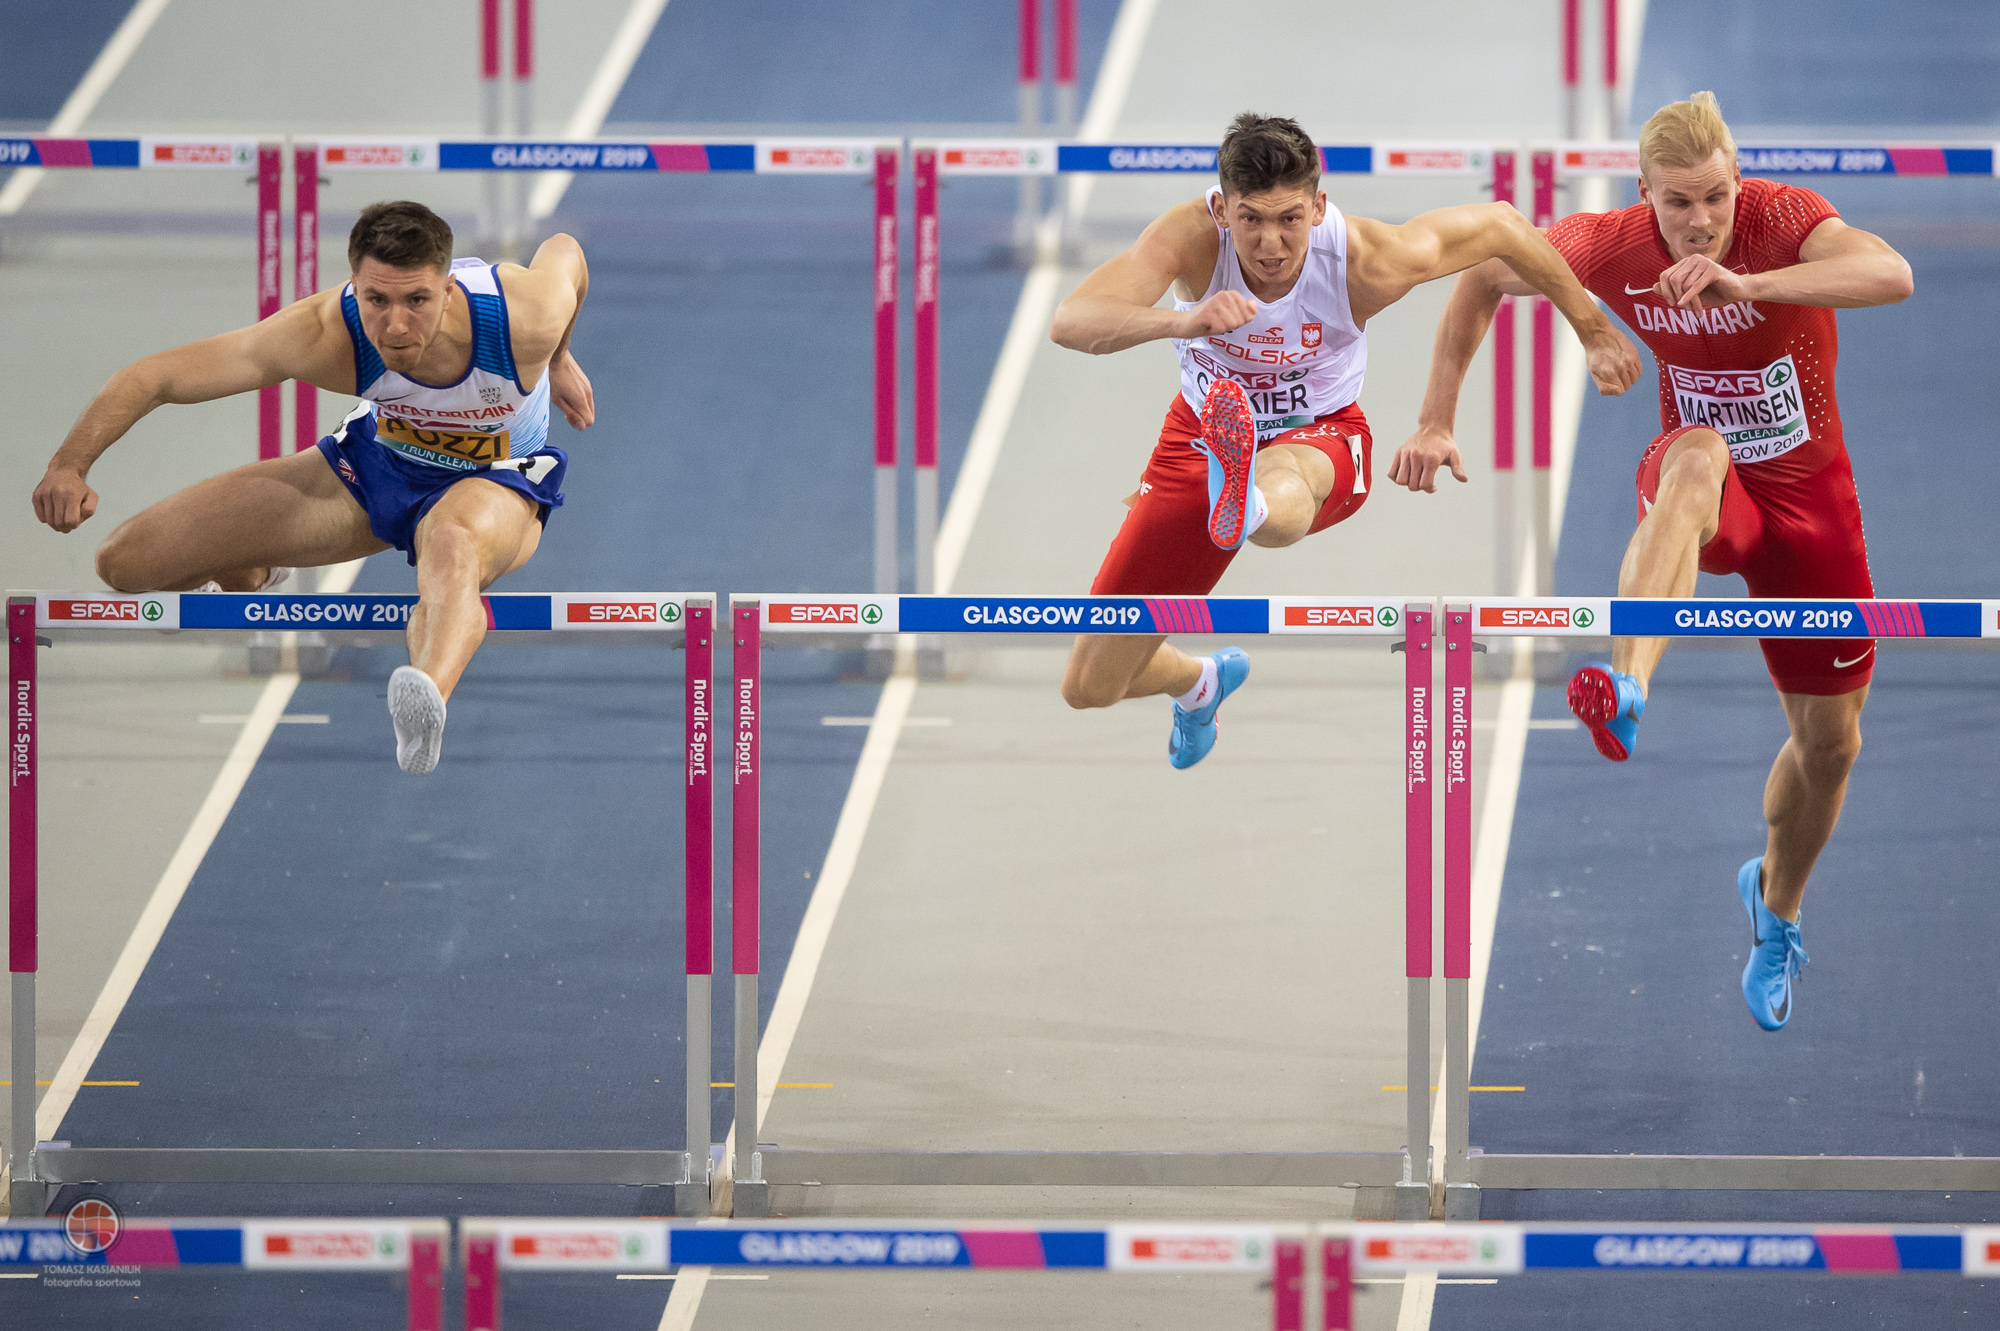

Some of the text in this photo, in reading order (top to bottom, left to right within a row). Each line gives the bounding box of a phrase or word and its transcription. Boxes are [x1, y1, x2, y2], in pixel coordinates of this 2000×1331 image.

[0, 142, 31, 162] 019
[492, 146, 599, 167] GLASGOW
[1634, 301, 1766, 335] DANMARK
[1249, 335, 1282, 344] ORLEN
[1194, 351, 1274, 388] SPAR
[1196, 371, 1310, 415] CKIER
[1675, 371, 1762, 395] SPAR
[1679, 385, 1799, 428] MARTINSEN
[1773, 429, 1804, 453] 2019
[402, 443, 478, 471] I RUN CLEAN
[70, 603, 137, 618] SPAR
[244, 603, 366, 622] GLASGOW
[589, 605, 656, 621] SPAR
[790, 606, 857, 622] SPAR
[962, 605, 1141, 625] GLASGOW 2019
[1306, 608, 1373, 625] SPAR
[1501, 609, 1568, 626] SPAR
[1674, 609, 1853, 629] GLASGOW 2019
[14, 733, 30, 777] Sport
[690, 731, 707, 776] Sport
[736, 731, 753, 775] Sport
[1409, 739, 1427, 784] Sport
[1448, 739, 1466, 784] Sport
